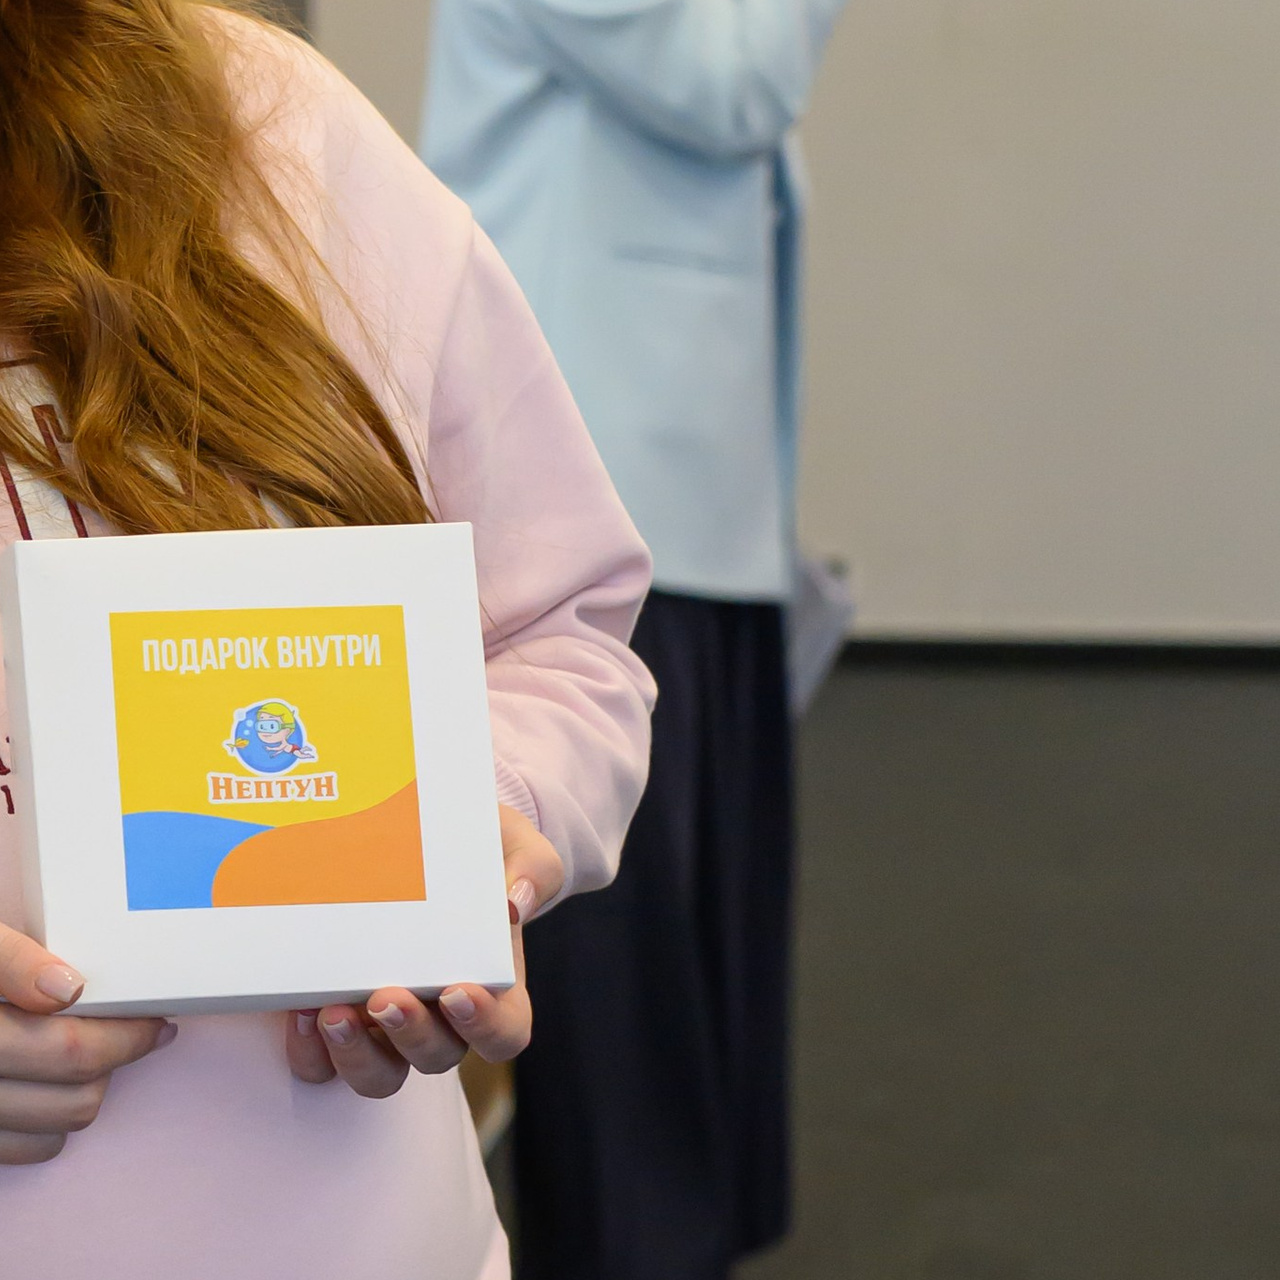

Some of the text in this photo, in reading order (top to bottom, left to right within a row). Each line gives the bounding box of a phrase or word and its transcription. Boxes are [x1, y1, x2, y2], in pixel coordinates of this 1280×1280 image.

[142, 634, 382, 674] ПОДАРОК ВНУТРИ
[209, 775, 336, 800] НЕПТУН
